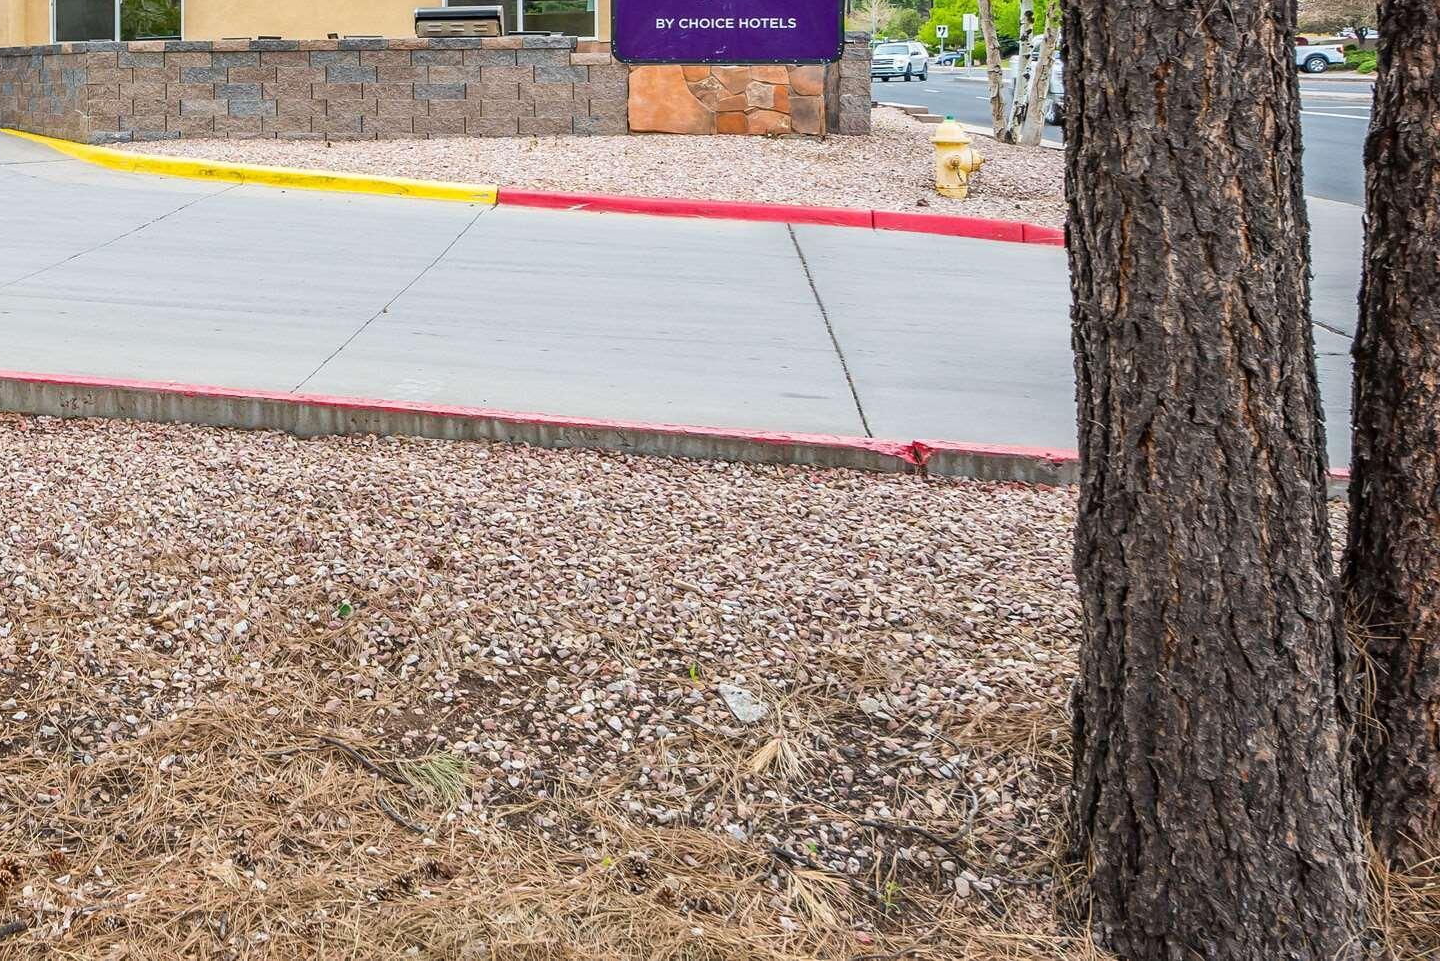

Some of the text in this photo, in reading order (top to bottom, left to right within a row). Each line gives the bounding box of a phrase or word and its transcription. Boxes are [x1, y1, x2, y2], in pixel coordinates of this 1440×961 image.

[656, 18, 797, 29] BY CHOICE HOTELS
